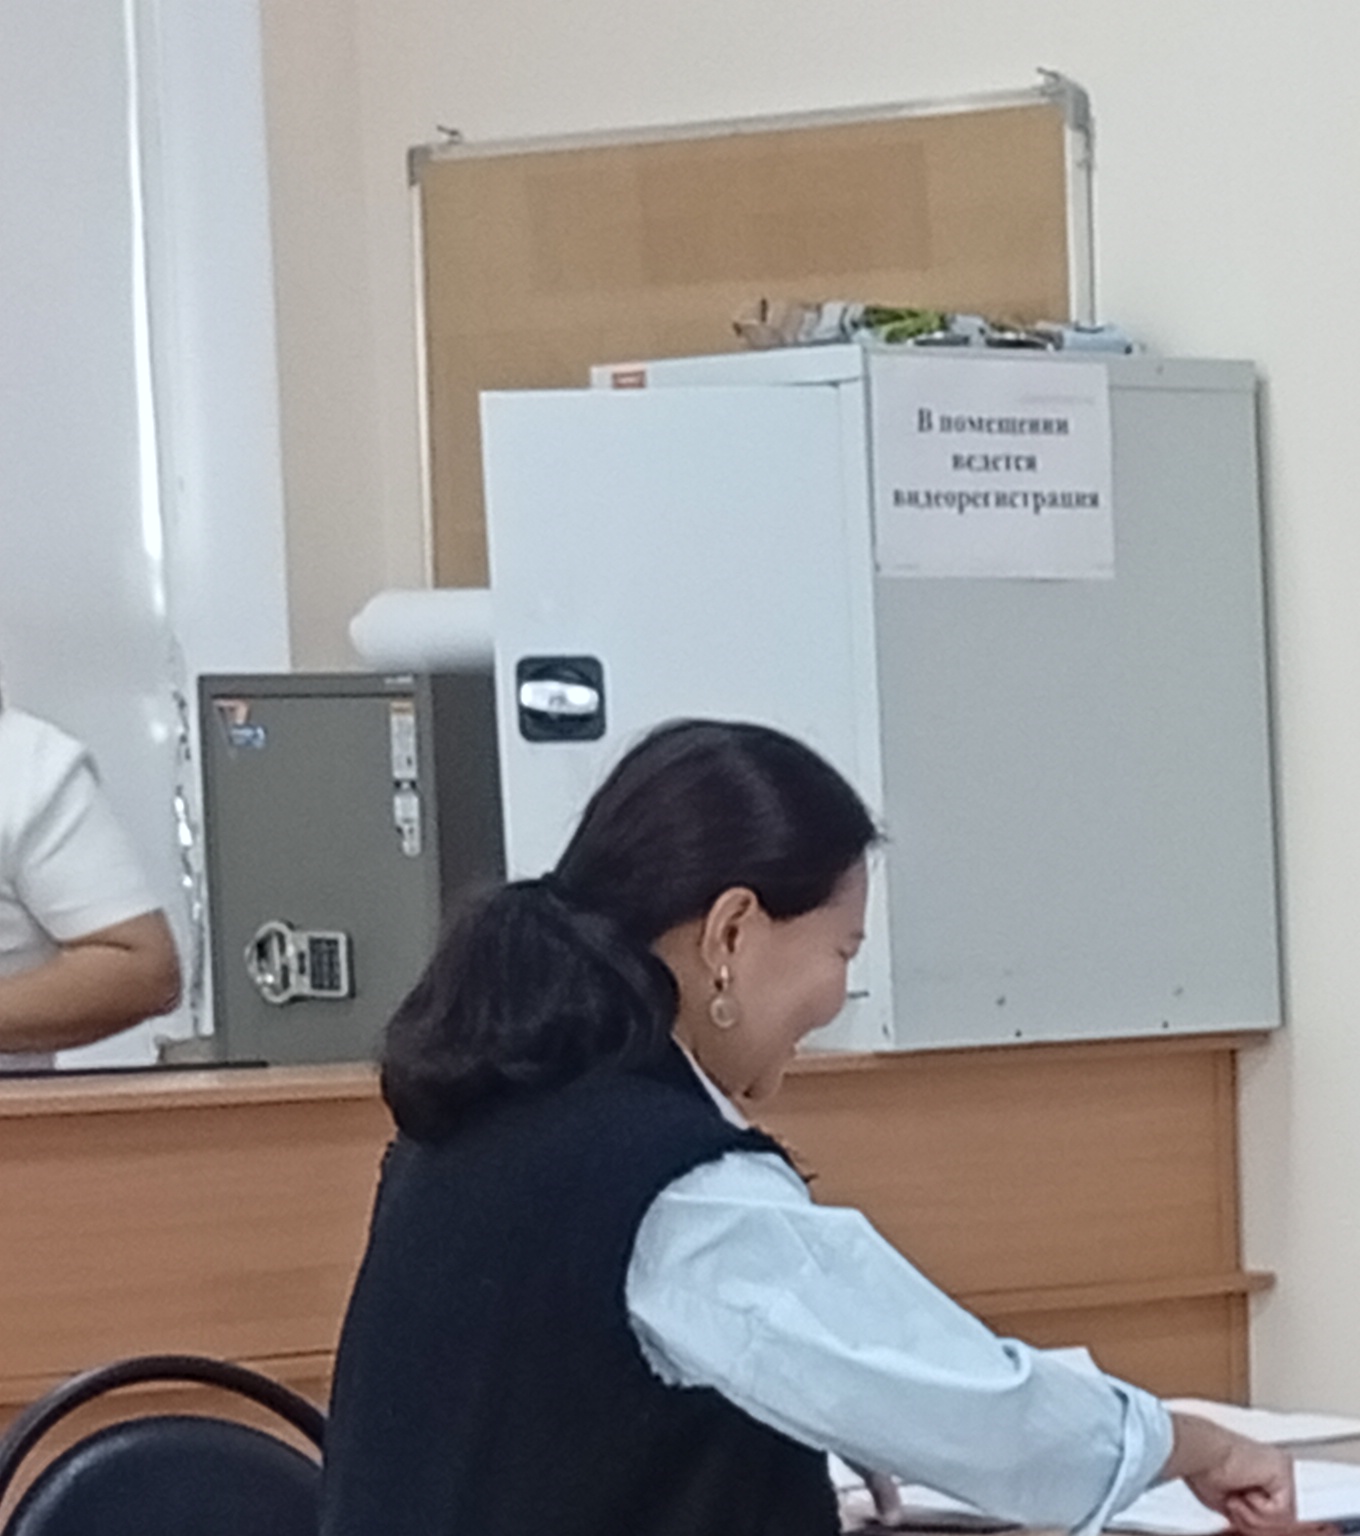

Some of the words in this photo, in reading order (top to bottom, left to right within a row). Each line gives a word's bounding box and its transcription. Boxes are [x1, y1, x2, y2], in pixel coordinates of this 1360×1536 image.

[917, 407, 933, 433] В
[939, 415, 1070, 436] помещении
[892, 488, 1100, 515] видеорегистрация
